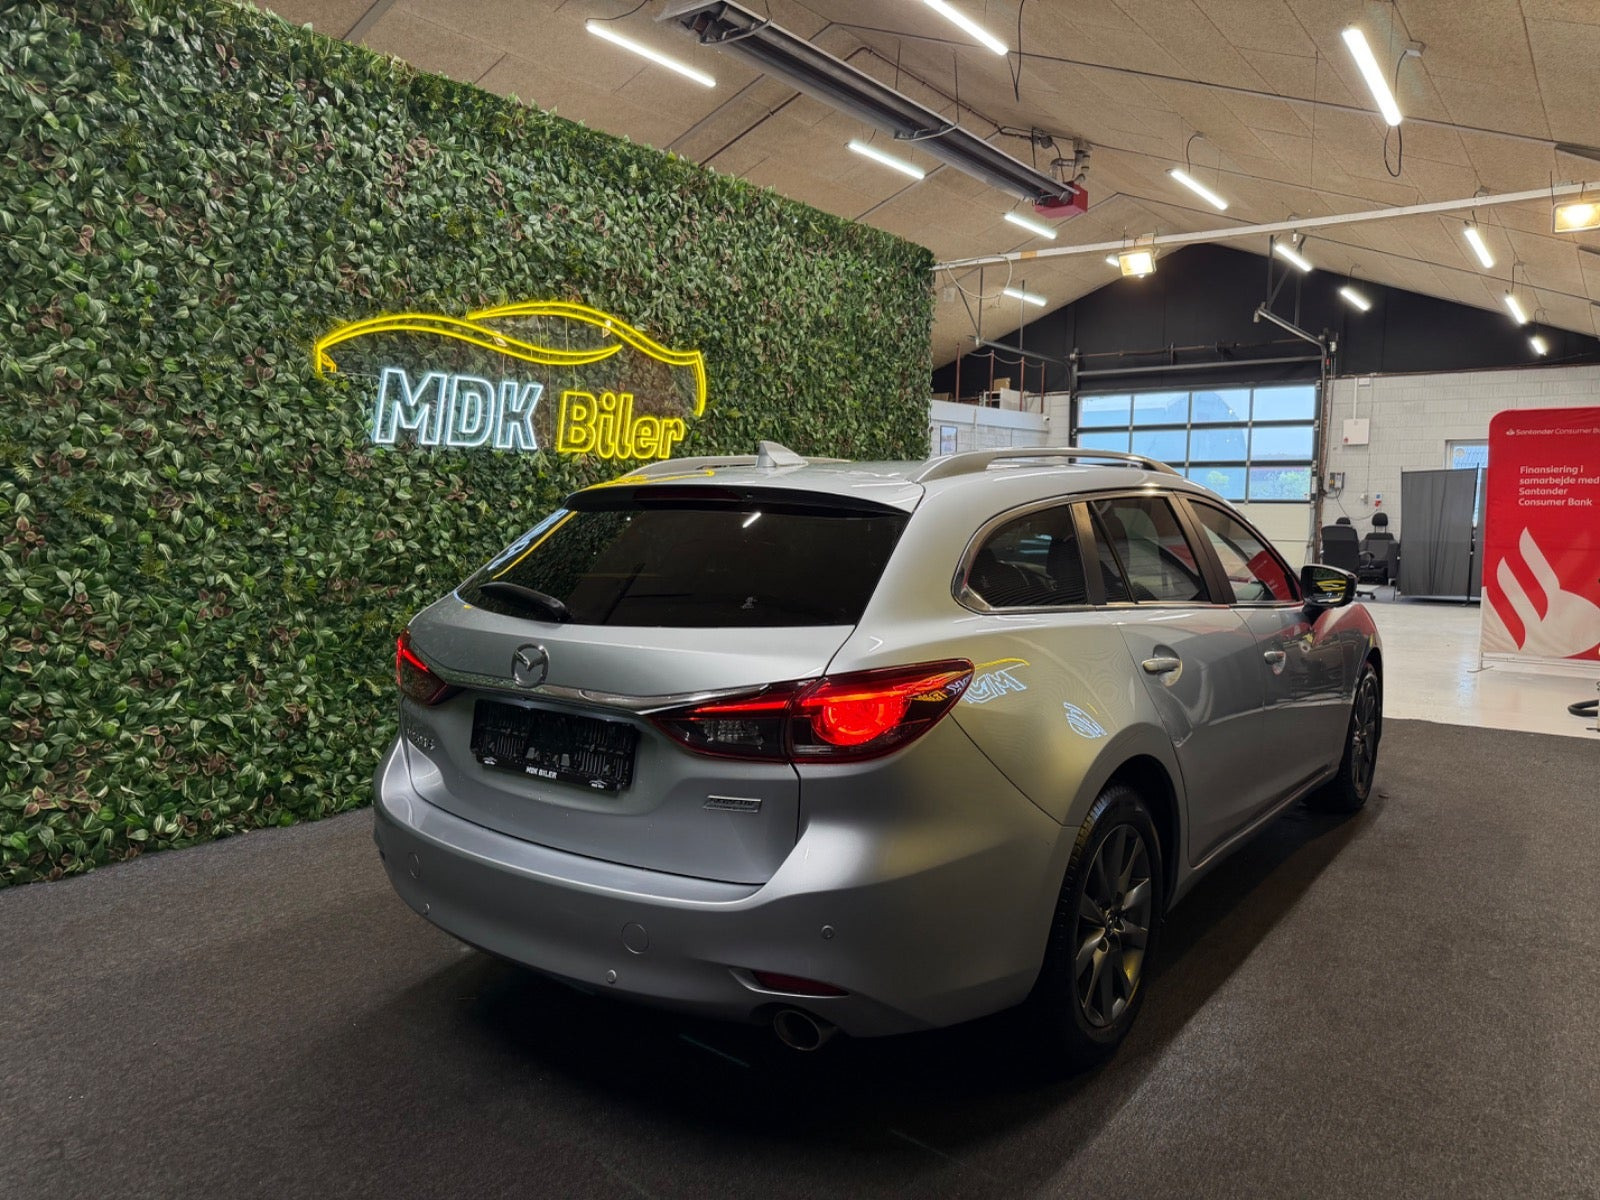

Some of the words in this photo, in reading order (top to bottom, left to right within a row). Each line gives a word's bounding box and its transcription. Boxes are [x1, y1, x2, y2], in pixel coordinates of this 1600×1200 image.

[372, 367, 544, 451] MDK
[557, 390, 686, 460] Biler
[1554, 427, 1592, 435] Consumer
[1519, 465, 1579, 475] Finansiering
[1580, 465, 1584, 473] i
[1519, 476, 1576, 486] samarbejde
[1577, 476, 1600, 484] med
[1518, 487, 1568, 495] Santander
[1518, 497, 1566, 506] Consumer
[1567, 497, 1593, 506] Bank
